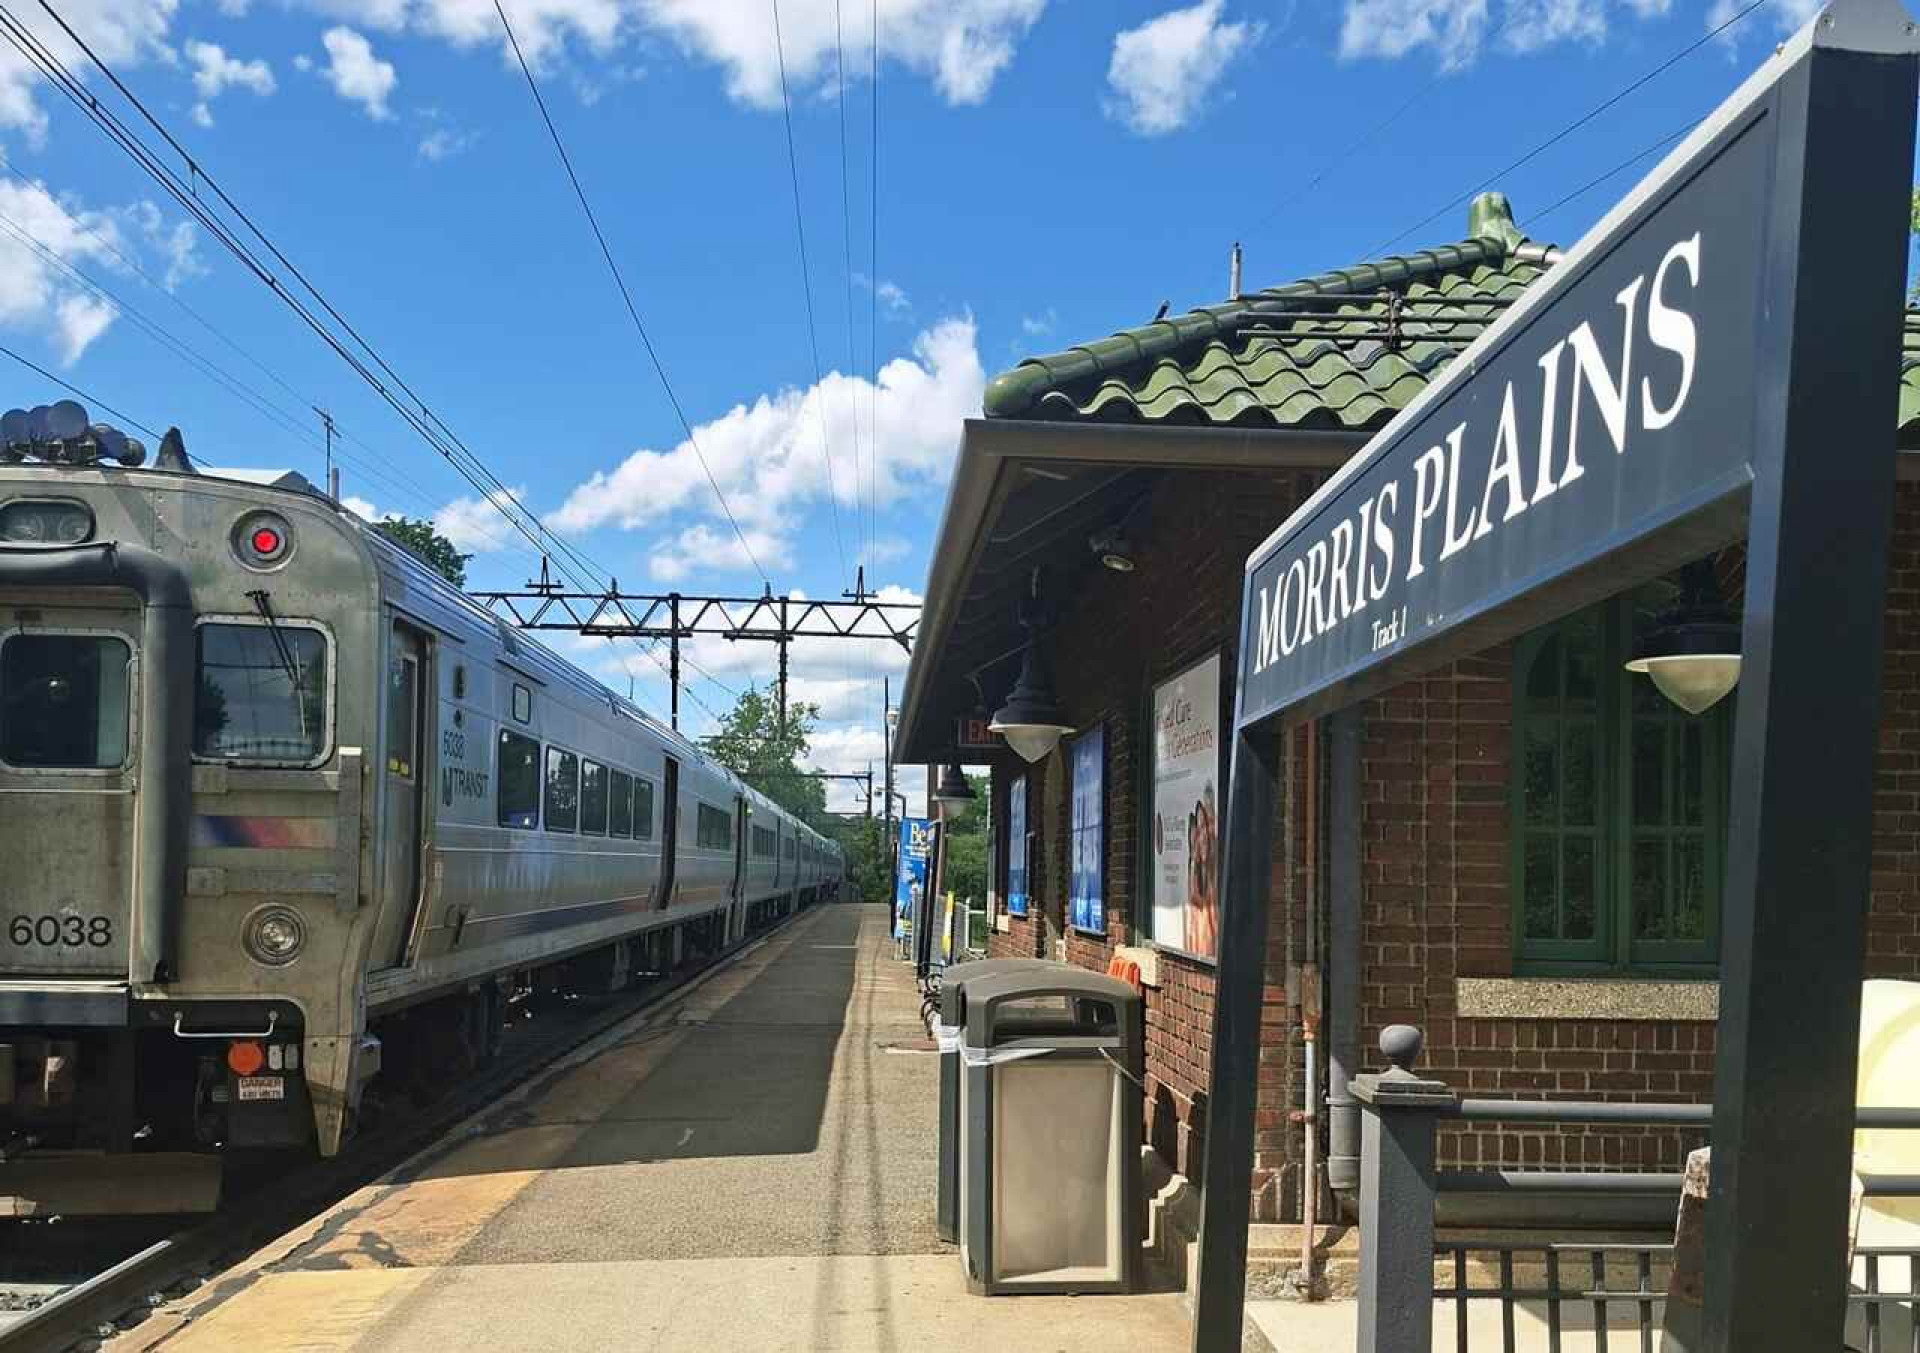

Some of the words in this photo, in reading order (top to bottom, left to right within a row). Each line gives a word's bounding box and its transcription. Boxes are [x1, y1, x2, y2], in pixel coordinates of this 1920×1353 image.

[1253, 479, 1399, 675] MORRIS
[1406, 231, 1702, 582] PLAINS
[1371, 608, 1398, 652] Track
[9, 914, 112, 947] 6038
